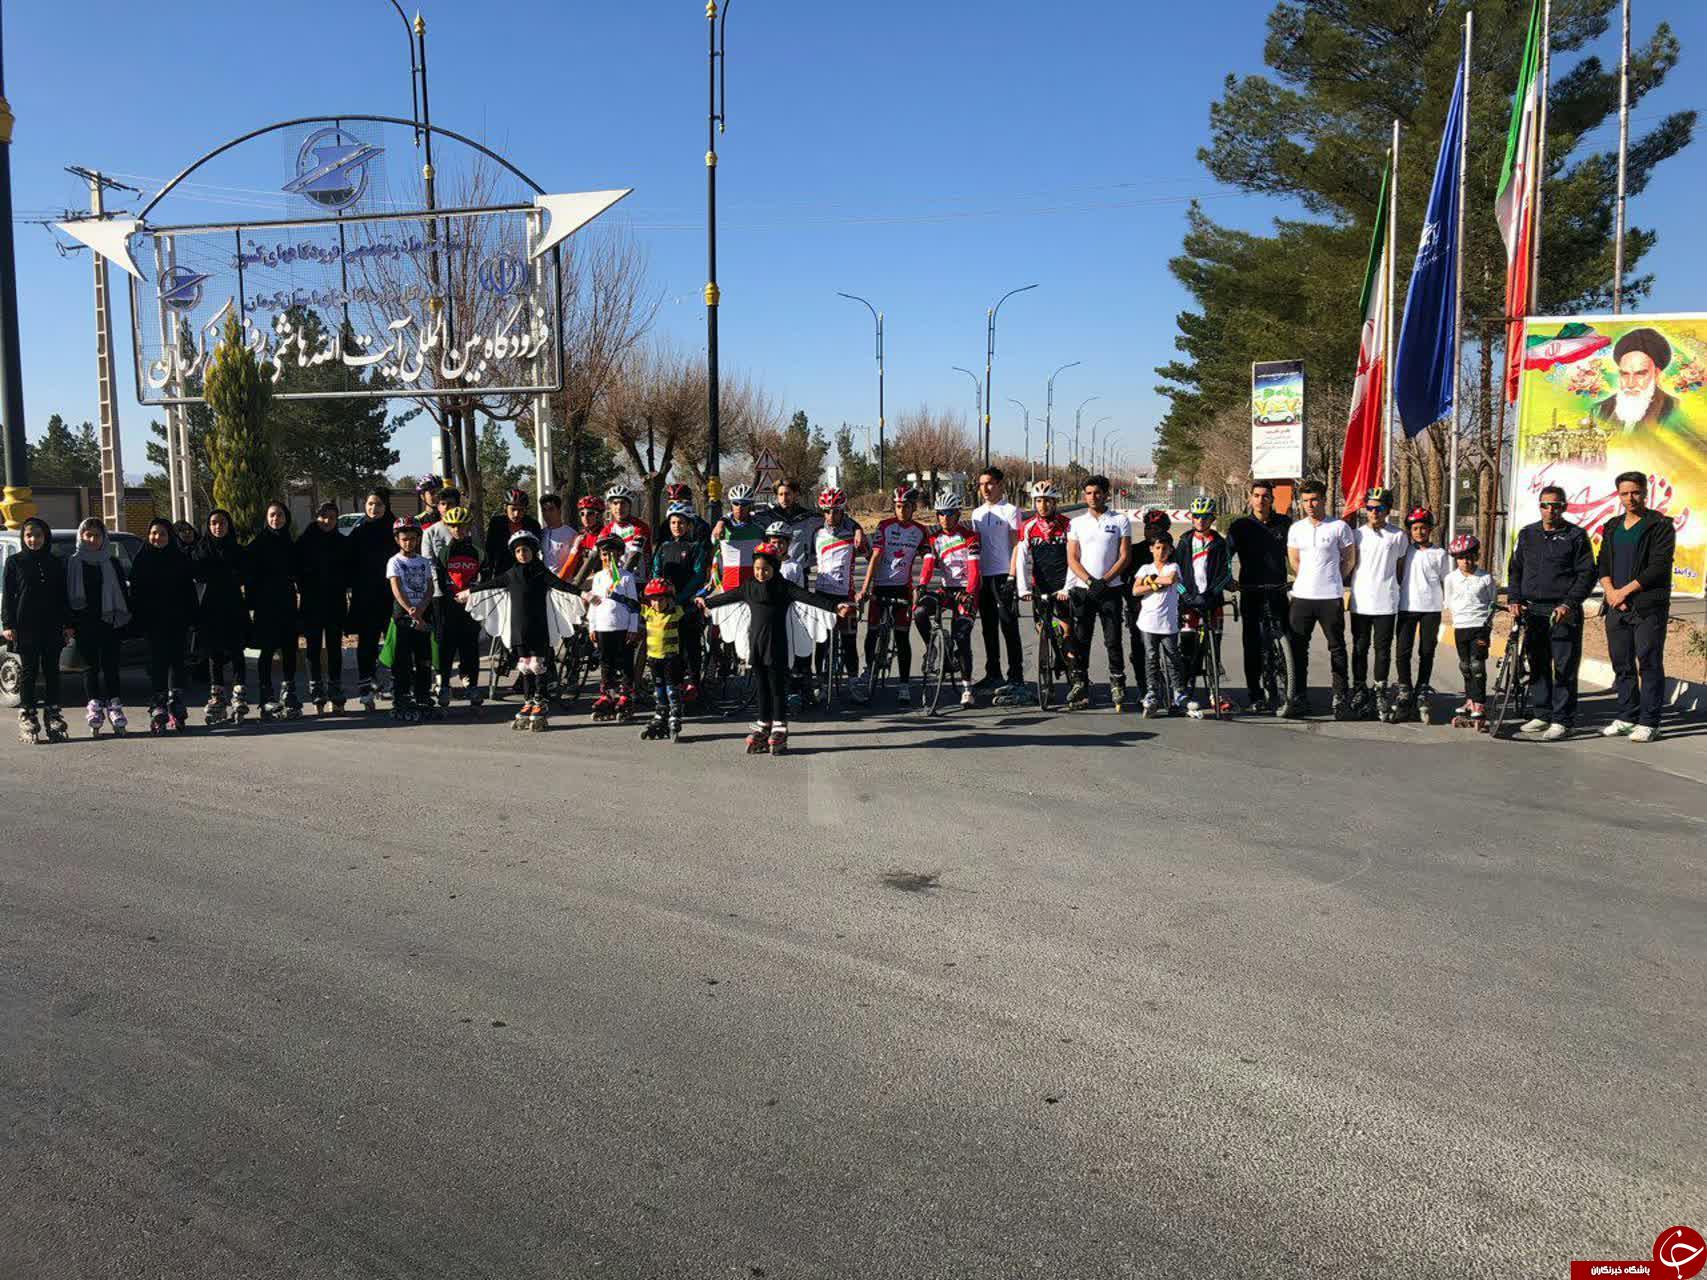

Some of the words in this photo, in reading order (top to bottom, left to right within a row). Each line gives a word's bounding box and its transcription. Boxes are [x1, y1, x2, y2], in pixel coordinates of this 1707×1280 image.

[401, 308, 447, 382] المللی
[441, 332, 487, 383] بین
[484, 301, 549, 359] فرودگاه
